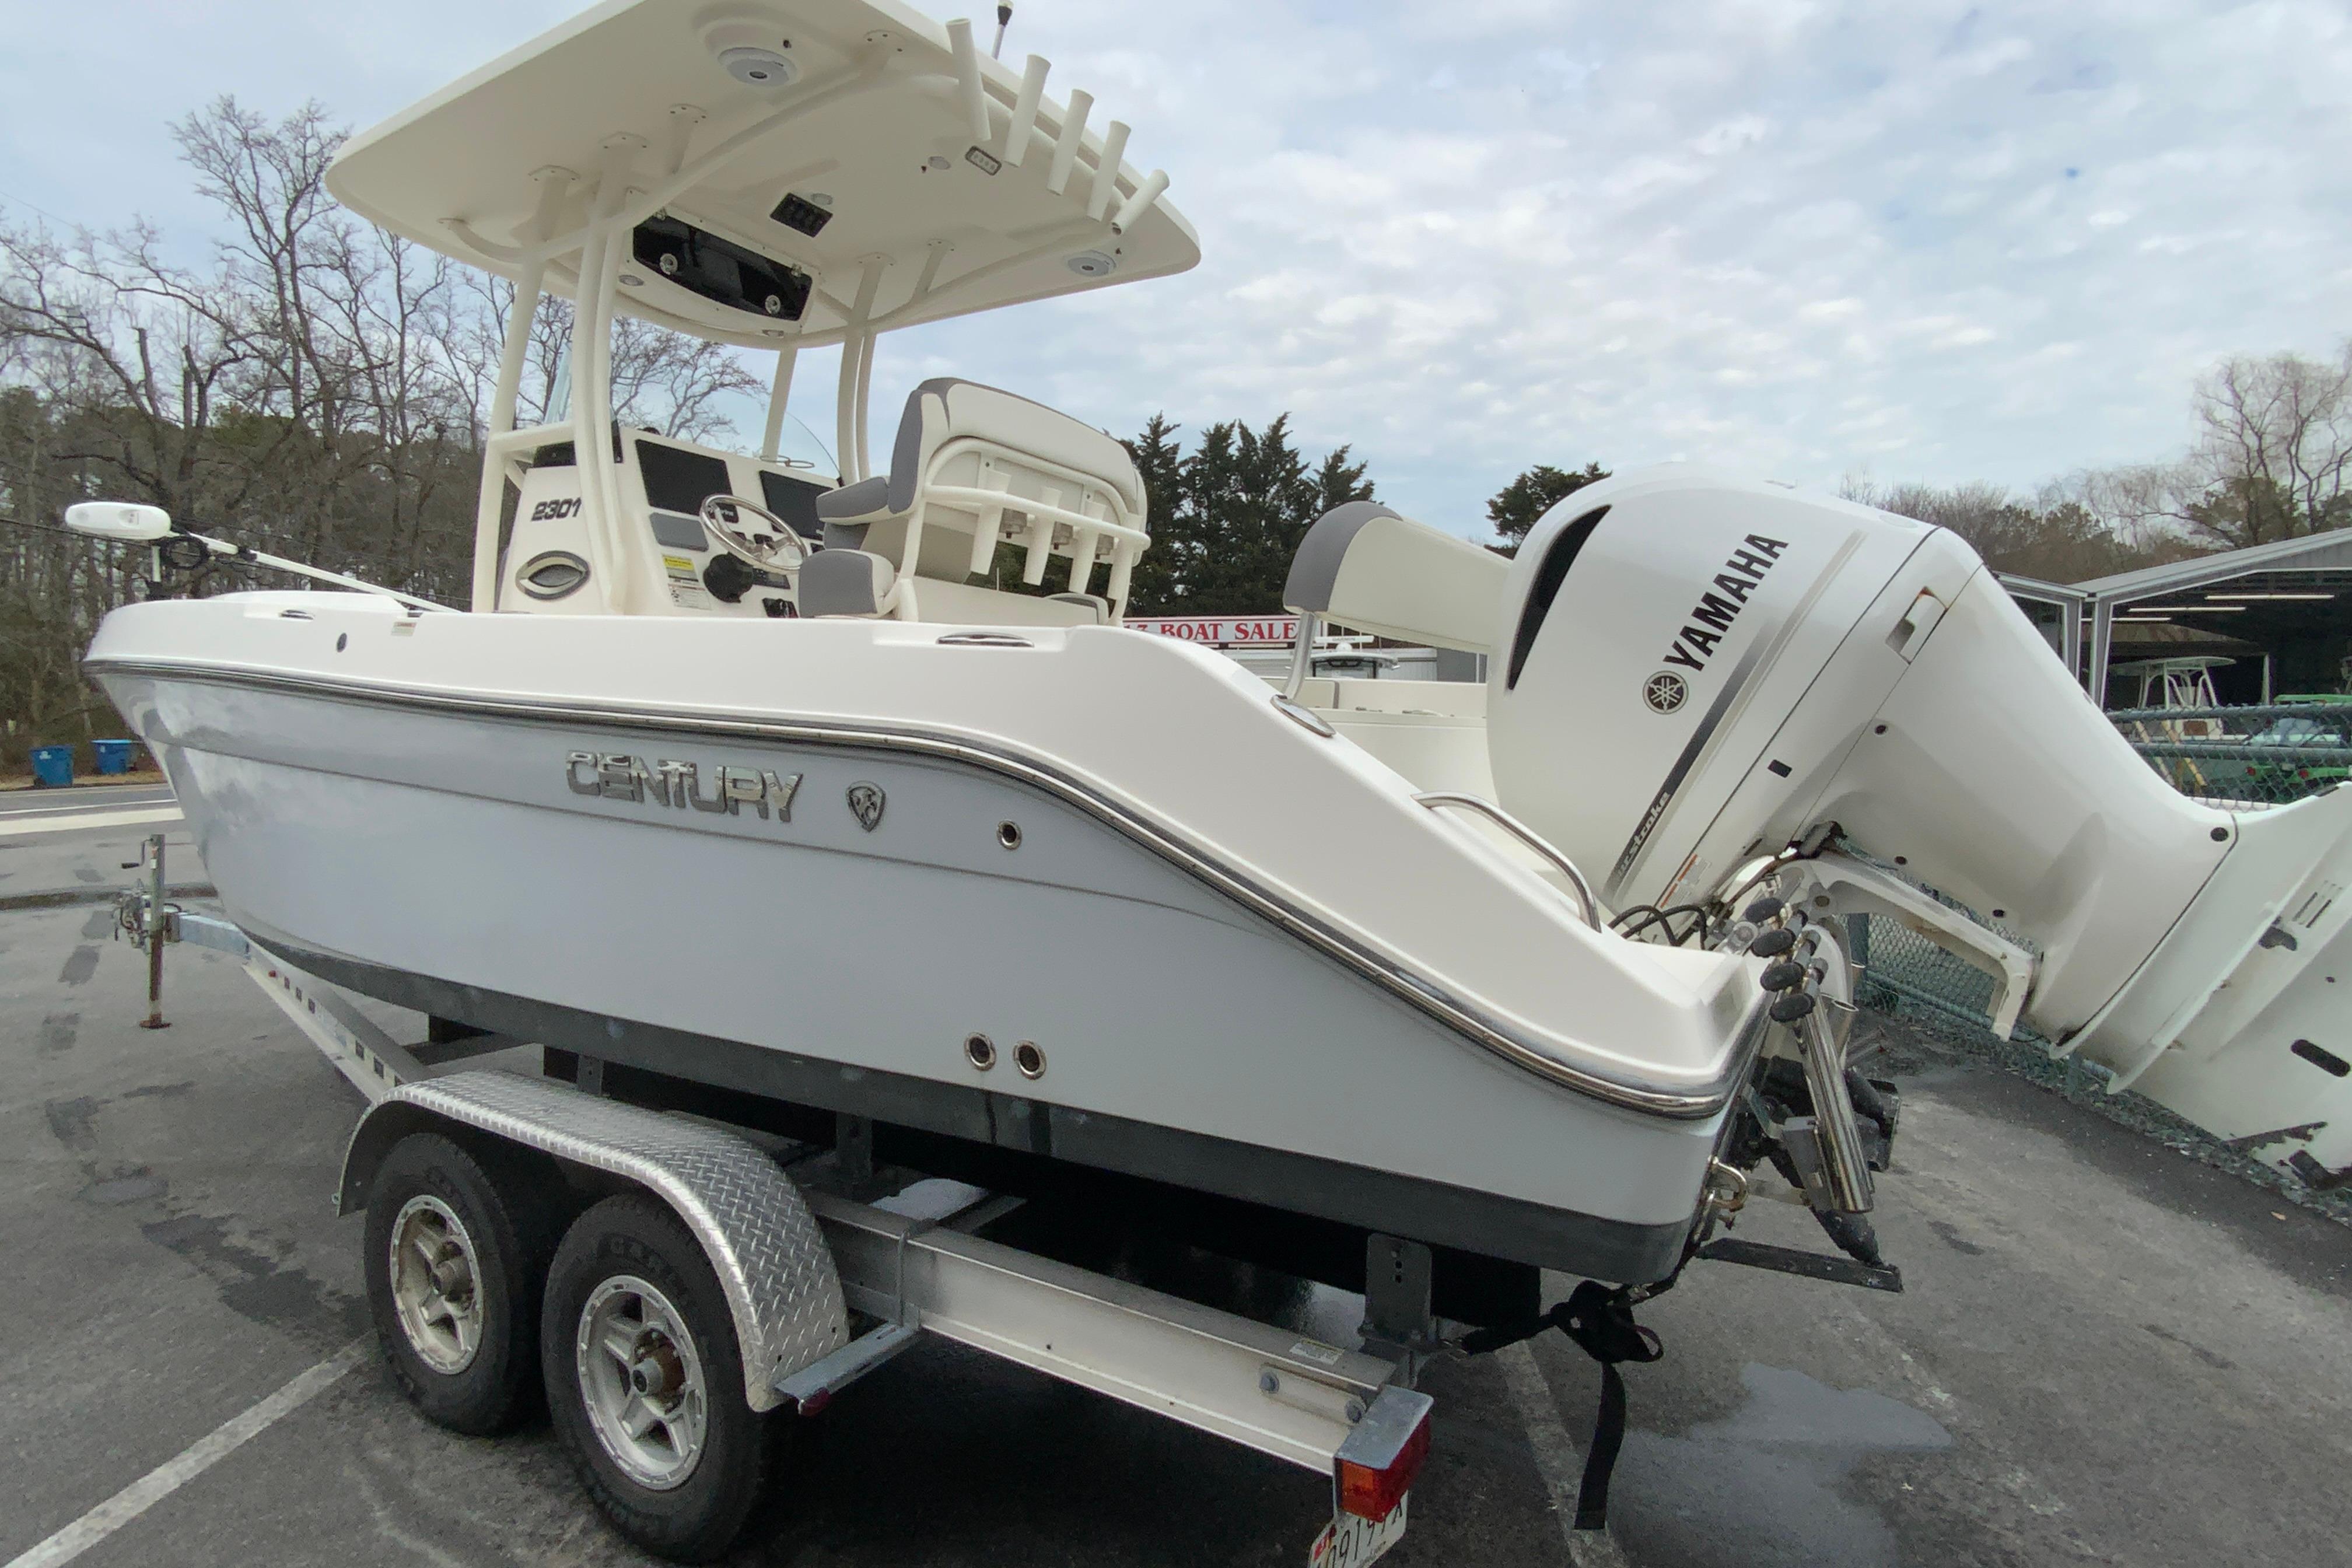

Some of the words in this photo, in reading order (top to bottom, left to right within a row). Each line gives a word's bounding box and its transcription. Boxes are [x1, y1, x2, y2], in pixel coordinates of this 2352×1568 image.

[531, 497, 582, 522] 2301
[1662, 533, 1789, 672] YAMAHA
[1160, 623, 1224, 640] BOAT
[565, 749, 804, 823] CENTURY
